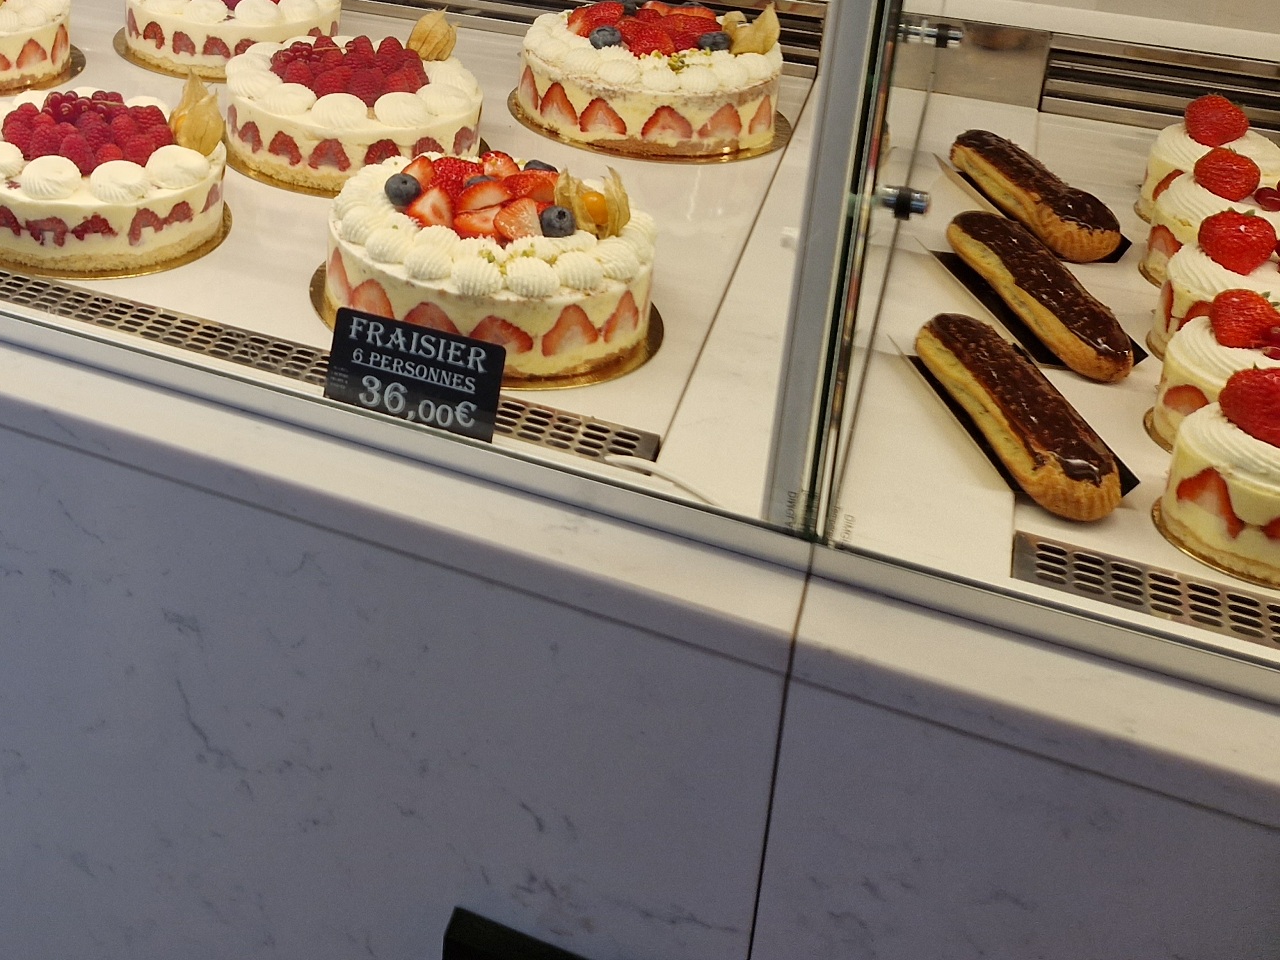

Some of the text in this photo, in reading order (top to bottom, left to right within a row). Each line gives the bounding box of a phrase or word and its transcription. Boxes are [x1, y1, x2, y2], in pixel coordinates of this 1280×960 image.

[348, 316, 488, 374] FRAISIER
[352, 347, 363, 362] 6
[369, 351, 476, 392] PERSONNES
[358, 375, 477, 428] 36,00€
